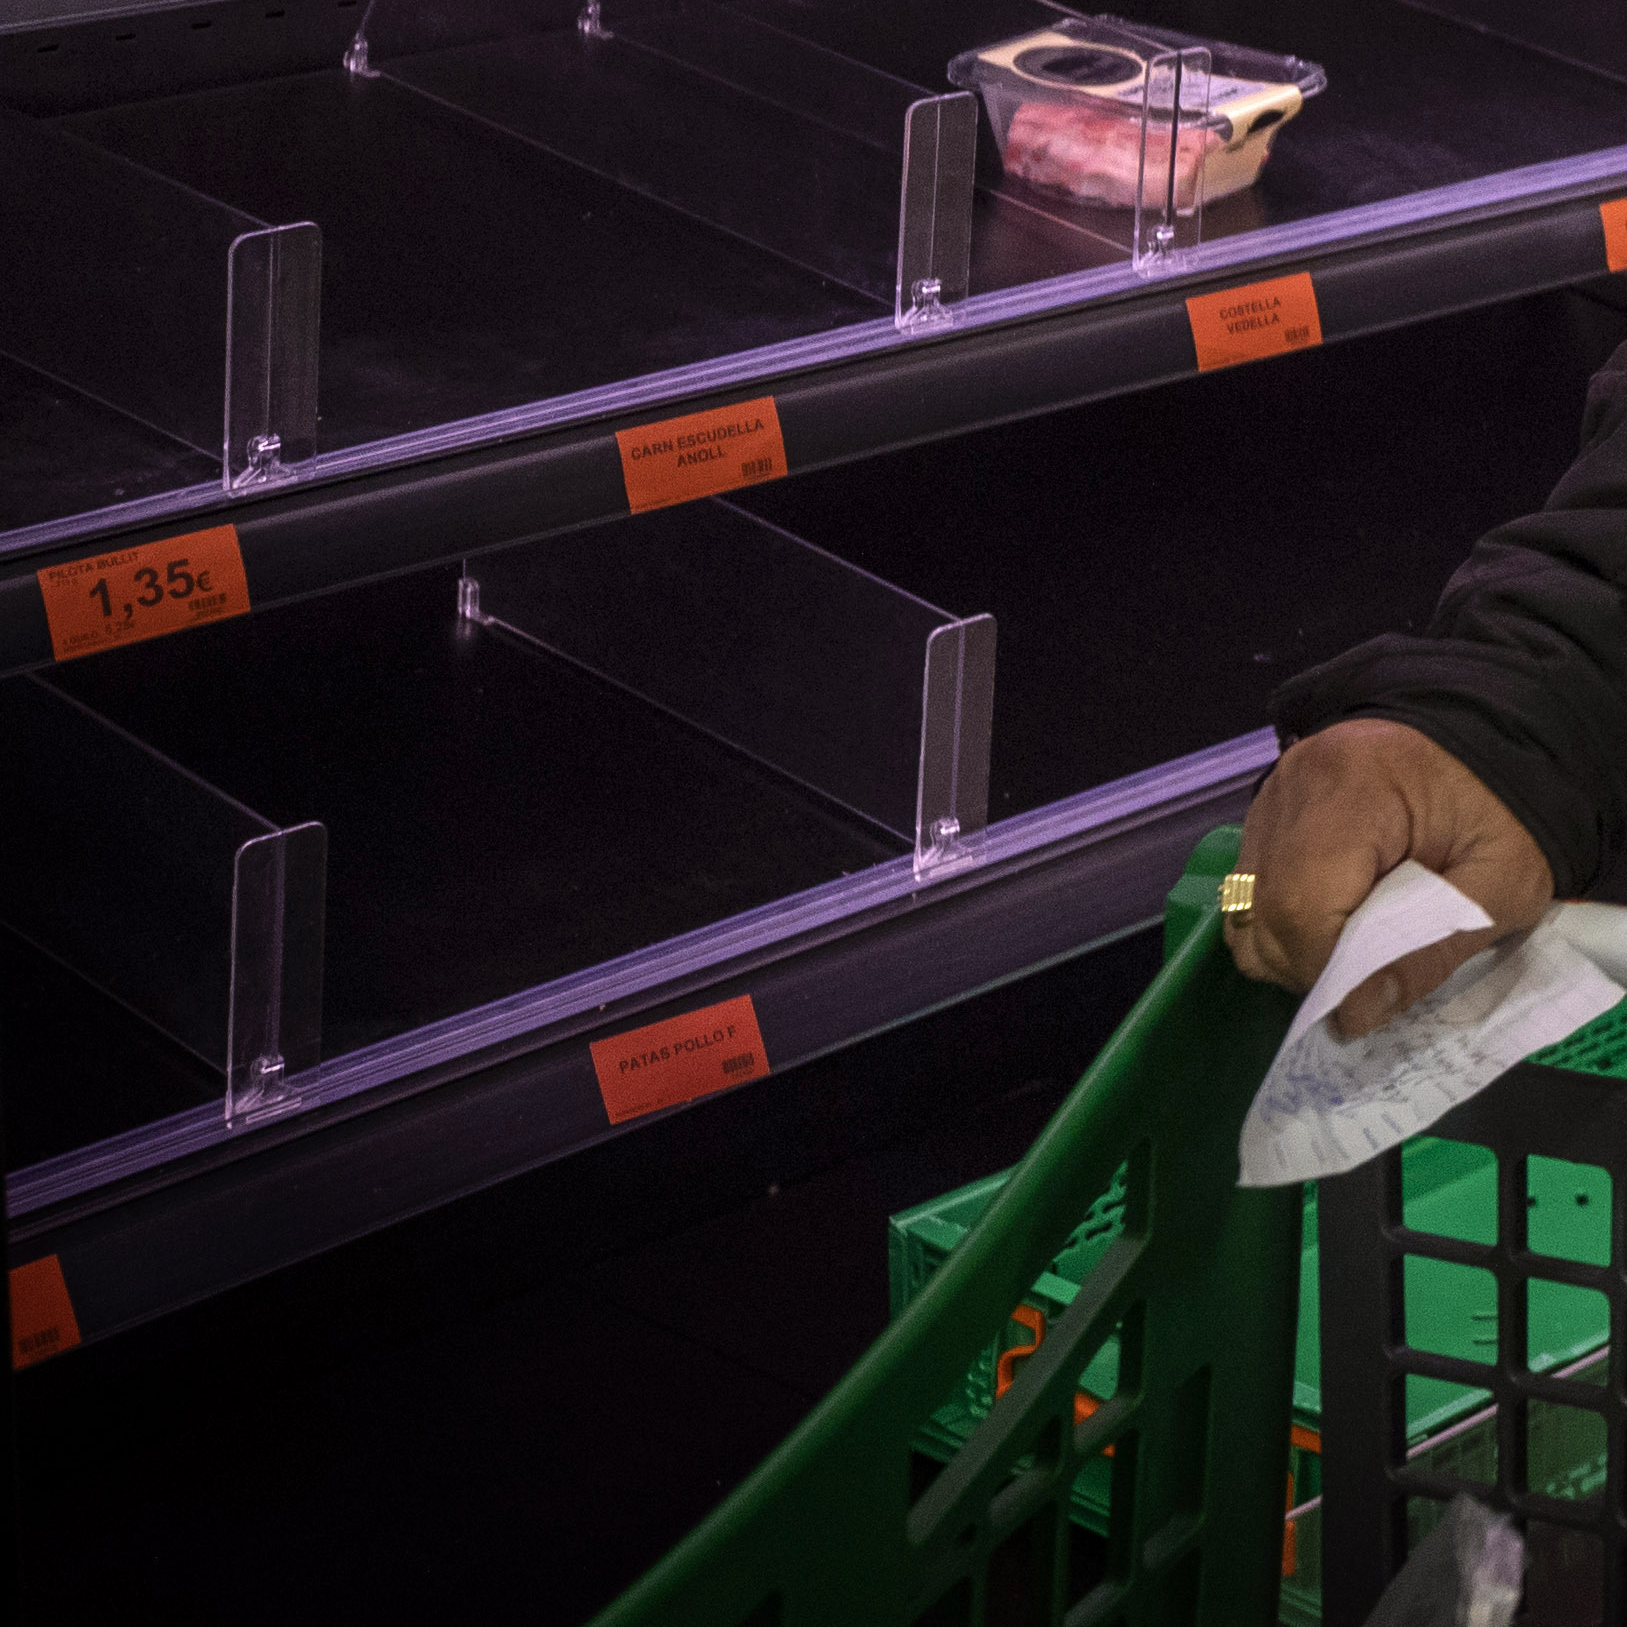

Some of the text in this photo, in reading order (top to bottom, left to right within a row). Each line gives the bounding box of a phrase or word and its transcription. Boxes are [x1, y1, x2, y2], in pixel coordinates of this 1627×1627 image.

[1219, 297, 1281, 320] COSTELLA
[1227, 313, 1280, 334] VEDELLA
[631, 418, 764, 461] CARN ESCUDELLA
[89, 559, 213, 621] 1,35€
[619, 1025, 736, 1074] PATAS POLLO F
